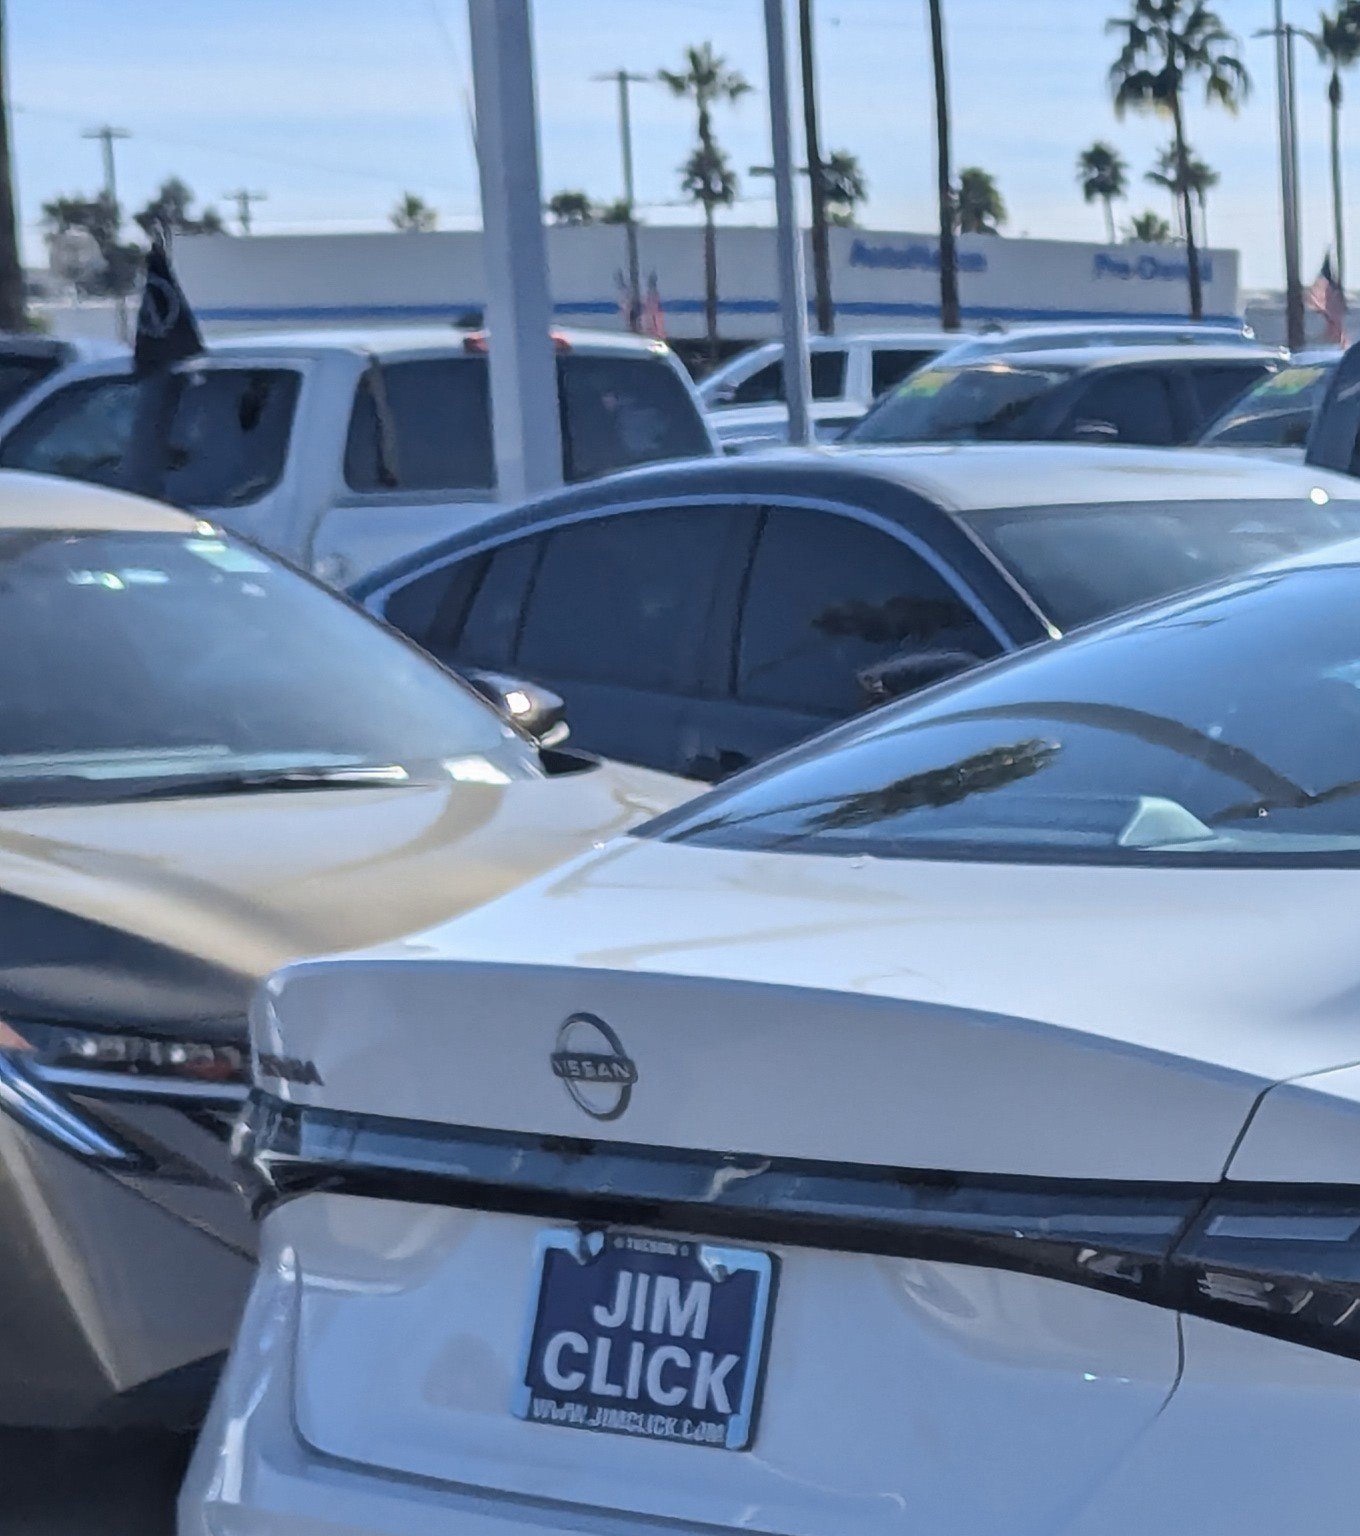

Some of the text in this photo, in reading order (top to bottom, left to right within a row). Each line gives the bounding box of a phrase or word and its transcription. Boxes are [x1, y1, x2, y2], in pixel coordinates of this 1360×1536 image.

[552, 1059, 632, 1079] NISSAN
[593, 1270, 711, 1340] JIM
[543, 1331, 740, 1414] CLICK
